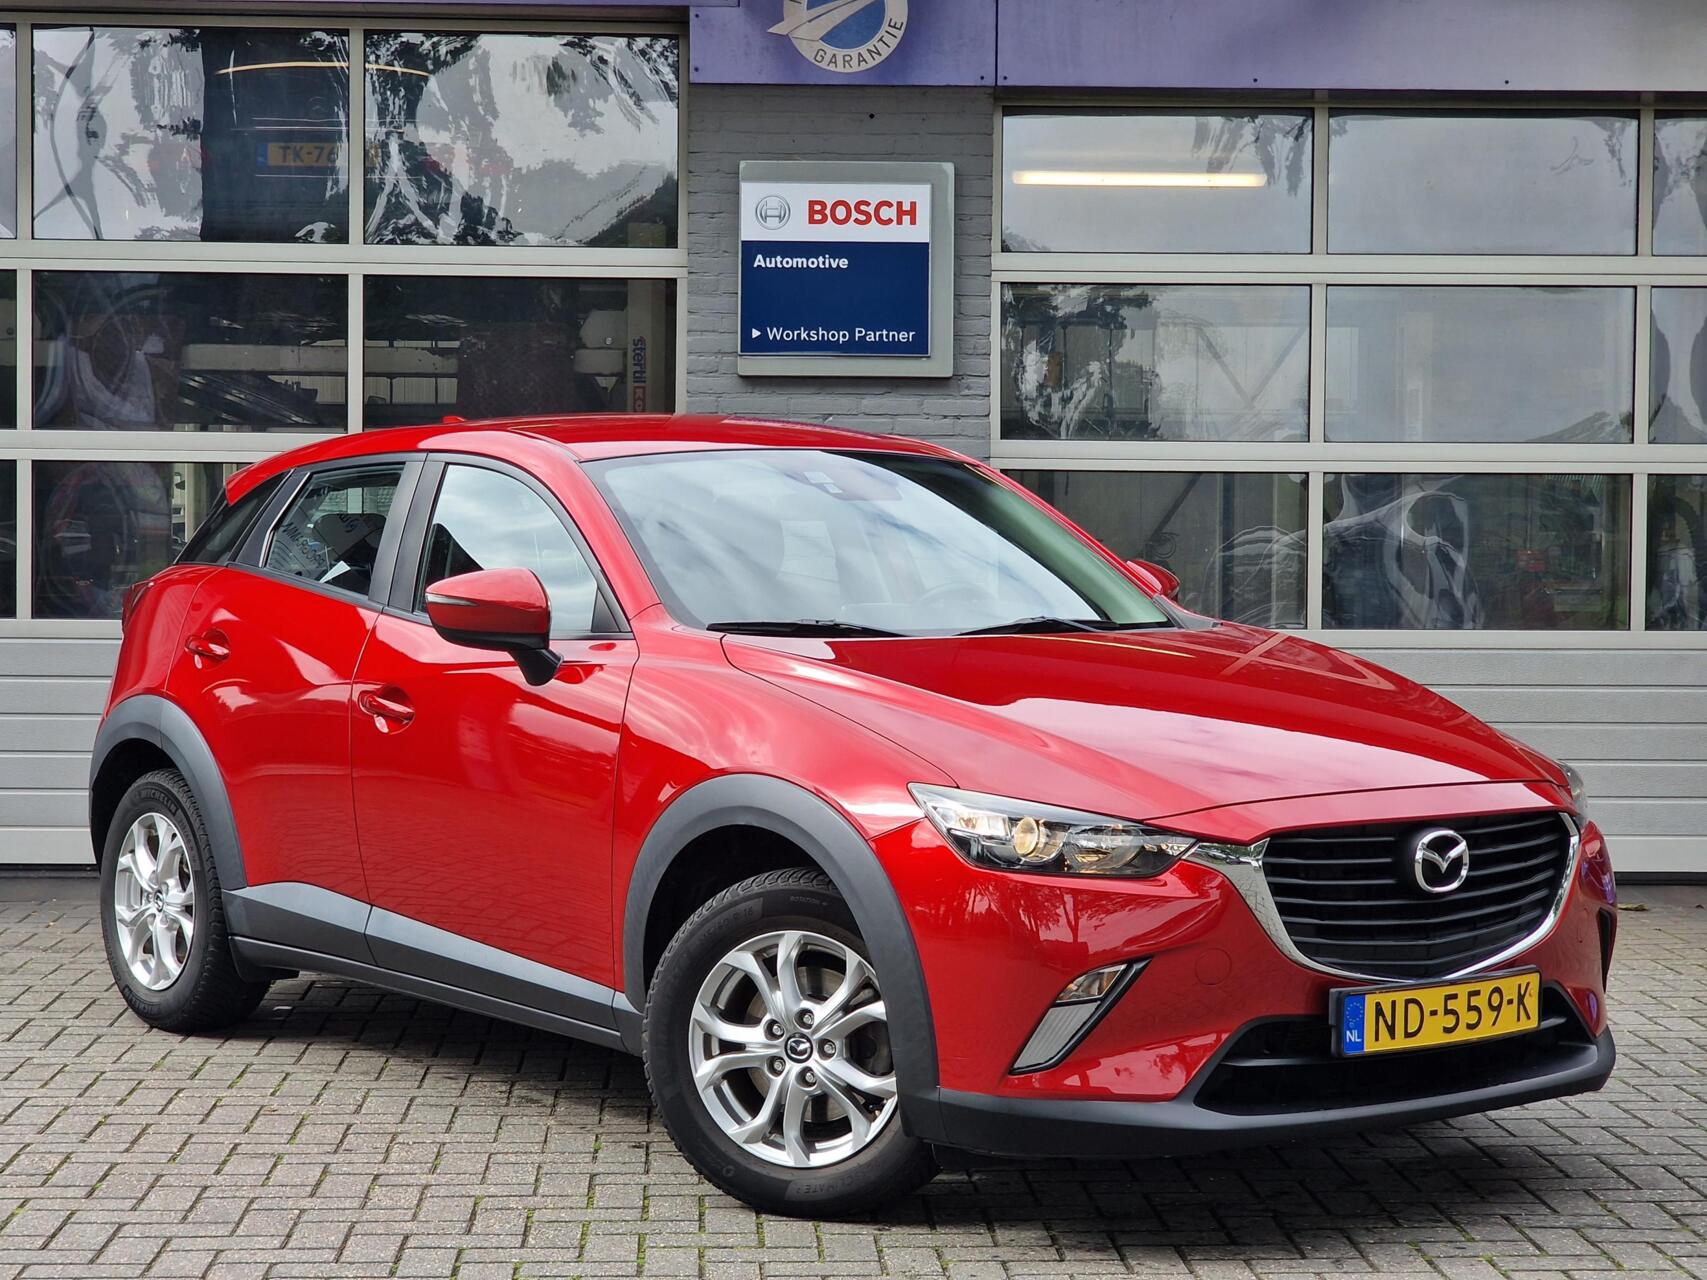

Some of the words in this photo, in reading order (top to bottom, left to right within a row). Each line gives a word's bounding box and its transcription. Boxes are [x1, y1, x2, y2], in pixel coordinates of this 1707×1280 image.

[812, 17, 904, 69] GARANTIE
[807, 199, 917, 226] BOSCH
[753, 253, 849, 269] Automotive
[766, 326, 850, 344] Workshop
[855, 327, 916, 342] Partner
[1374, 981, 1532, 1043] ND-559-K
[1346, 1030, 1362, 1043] NL
